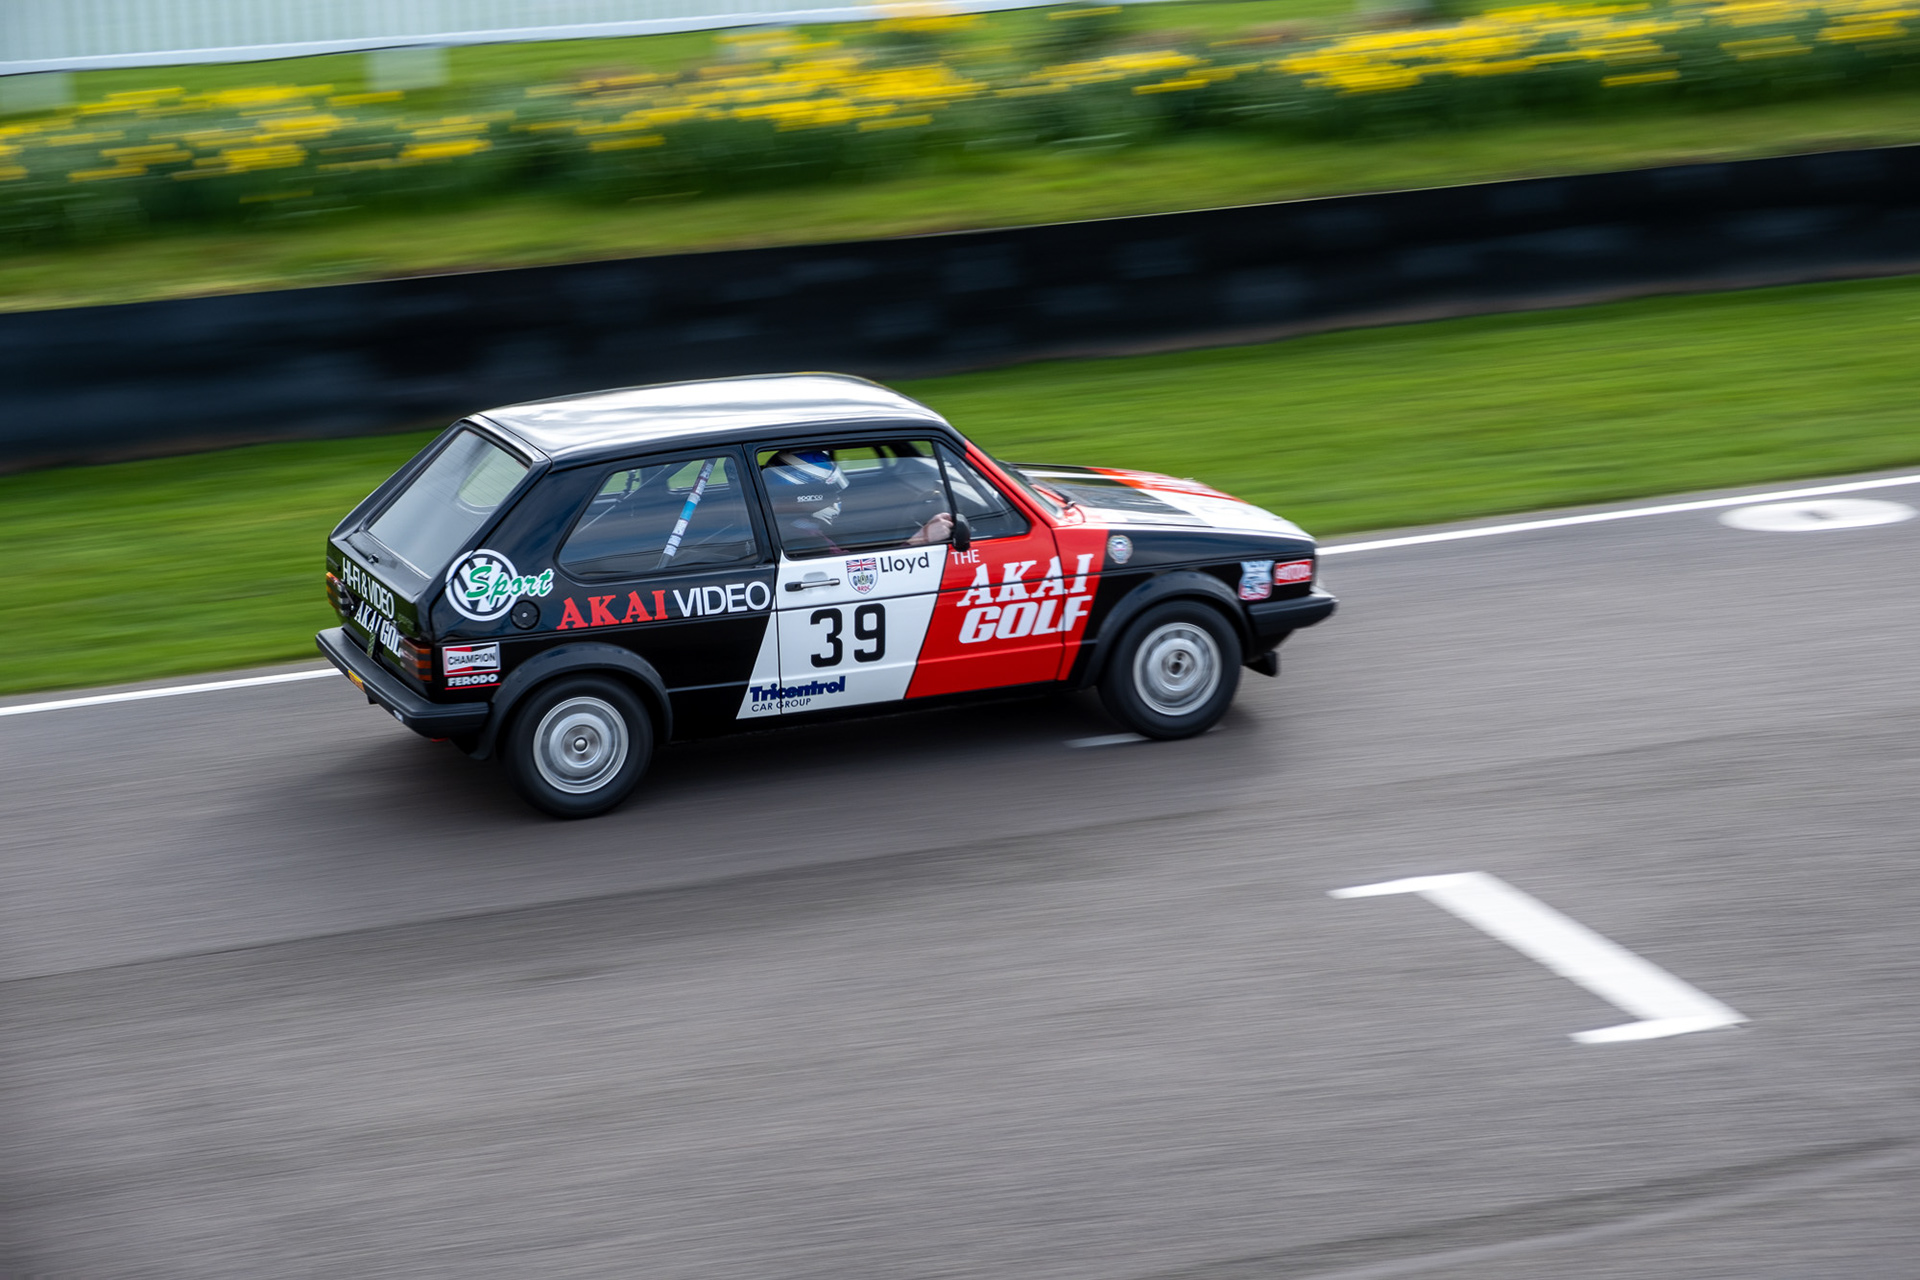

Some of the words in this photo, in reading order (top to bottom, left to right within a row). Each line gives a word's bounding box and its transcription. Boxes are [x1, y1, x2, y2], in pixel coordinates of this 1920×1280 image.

[797, 494, 823, 503] sparco
[880, 553, 930, 574] Lloyd
[951, 549, 981, 565] THE
[466, 566, 553, 605] Sport
[956, 553, 1094, 608] AKAI
[367, 576, 395, 619] VIDEO
[556, 589, 668, 630] AKAI
[672, 581, 771, 617] VIDEO
[354, 600, 382, 634] AKAI
[380, 619, 403, 658] GOL
[810, 603, 886, 668] 39
[958, 595, 1093, 644] GOLF
[447, 652, 497, 666] CHAMPION
[447, 673, 499, 686] FERODO
[749, 675, 846, 703] Tricentrol
[751, 702, 773, 712] CAR
[775, 697, 812, 710] GROUP
